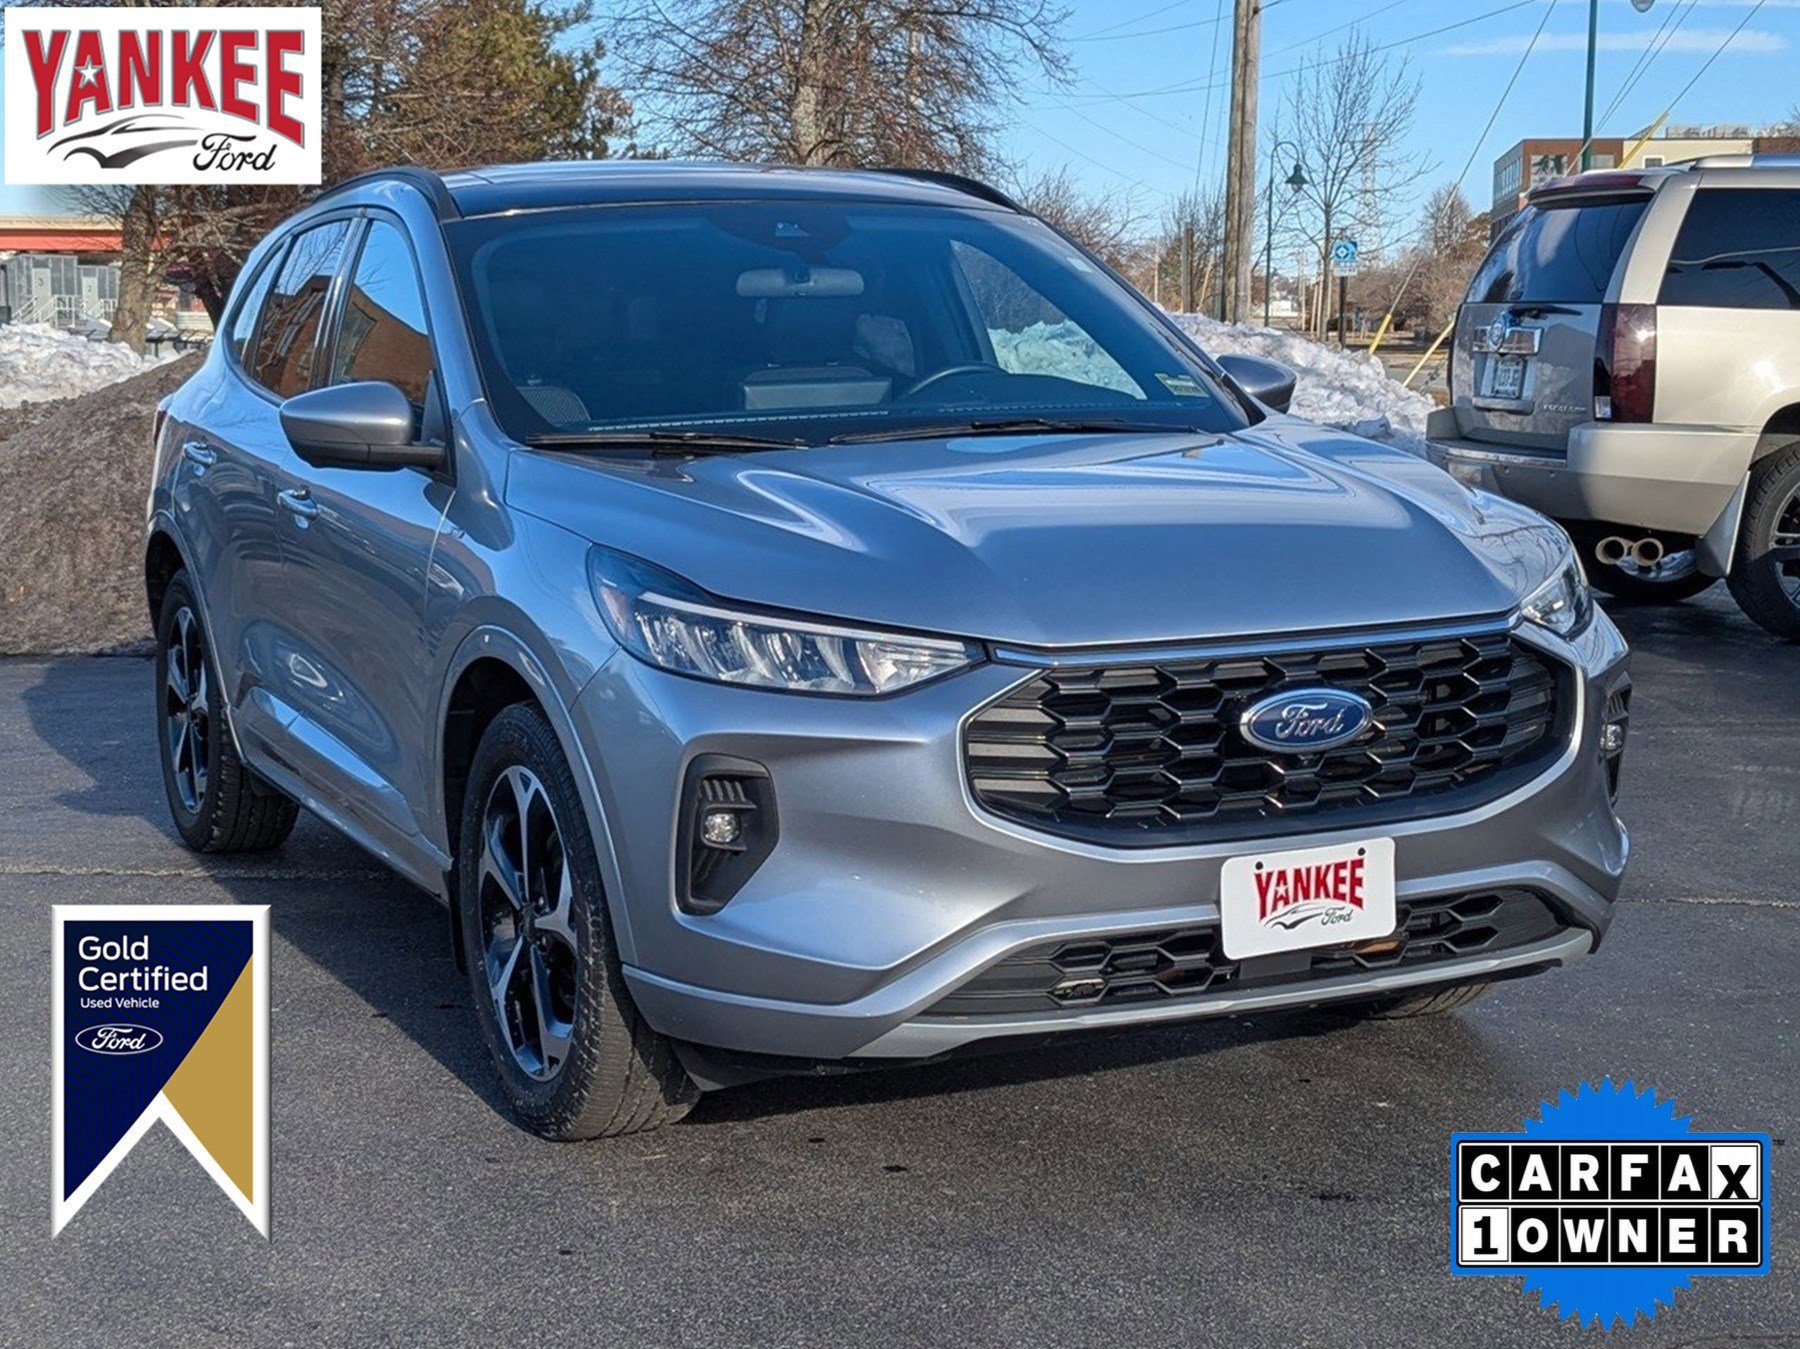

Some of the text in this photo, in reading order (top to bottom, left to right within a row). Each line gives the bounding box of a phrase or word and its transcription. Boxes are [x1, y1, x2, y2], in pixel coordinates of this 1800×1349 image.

[1275, 702, 1344, 739] Ford
[1254, 858, 1364, 921] YANKEE
[1320, 906, 1353, 926] Ford
